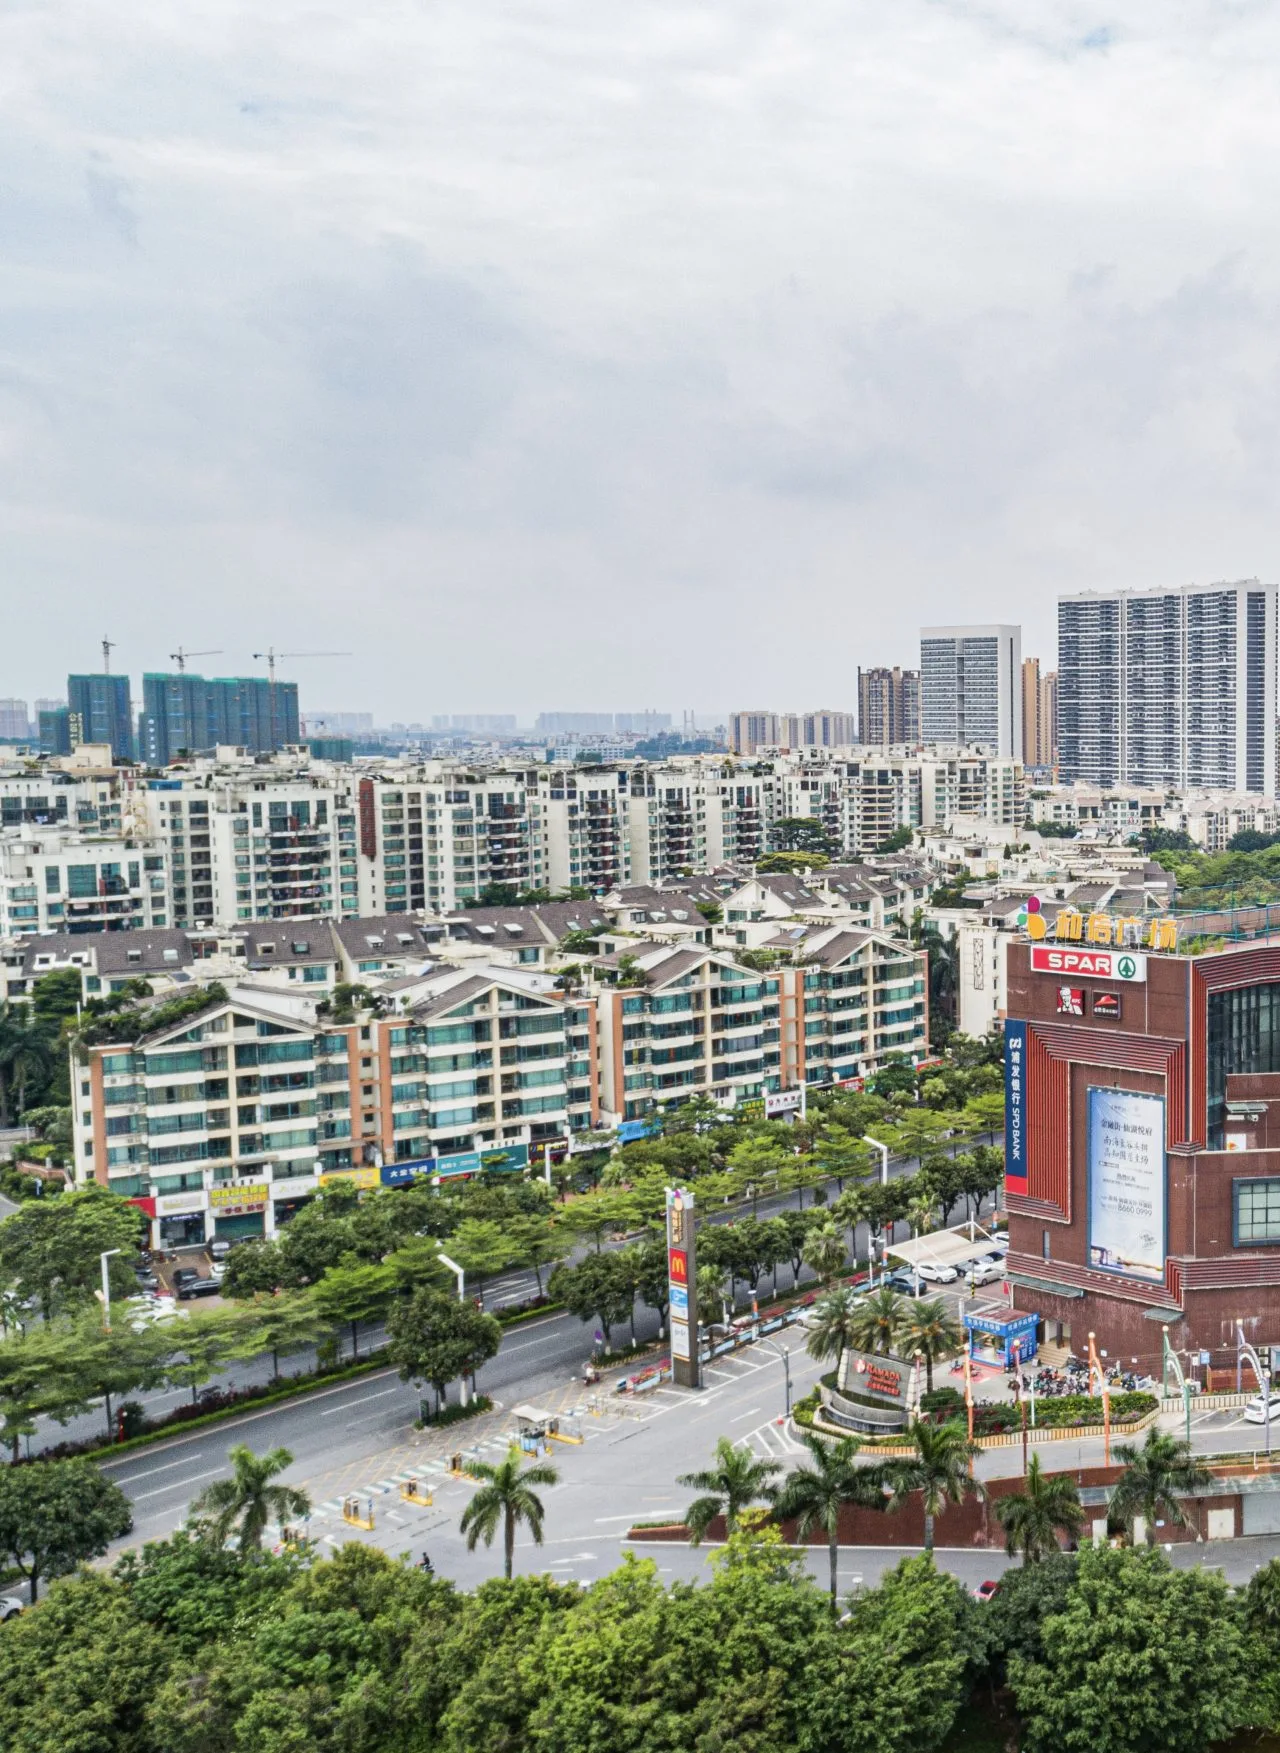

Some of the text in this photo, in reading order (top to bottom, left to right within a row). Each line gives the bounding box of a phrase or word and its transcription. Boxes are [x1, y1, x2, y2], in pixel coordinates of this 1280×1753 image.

[1055, 909, 1178, 949] 和信广场
[1048, 953, 1110, 973] SPAR
[1011, 1051, 1021, 1105] 浦发银行
[1012, 1108, 1021, 1160] SPD BANK
